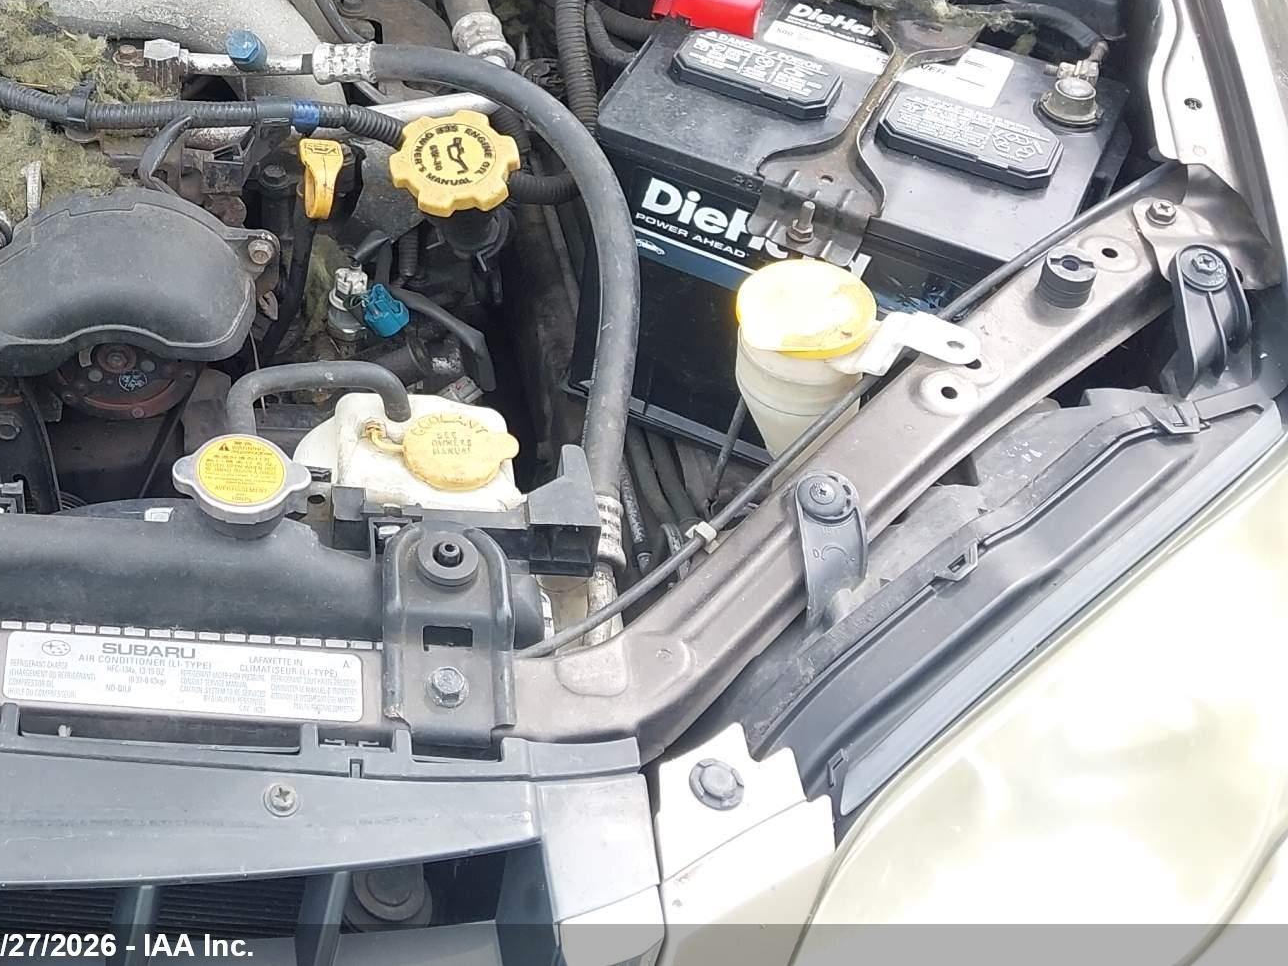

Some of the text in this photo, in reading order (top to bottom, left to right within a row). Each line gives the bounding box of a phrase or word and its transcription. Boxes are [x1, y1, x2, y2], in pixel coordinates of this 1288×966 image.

[464, 127, 494, 175] ENGINE OIL
[425, 172, 473, 186] MANUAL
[635, 212, 746, 259] POWER AHEAD
[102, 642, 196, 659] SUBARU
[79, 655, 95, 663] AIR
[98, 655, 165, 667] CONDITIONER
[249, 656, 303, 666] LAFAYETTE IN
[239, 664, 297, 675] CLIMATISEUR
